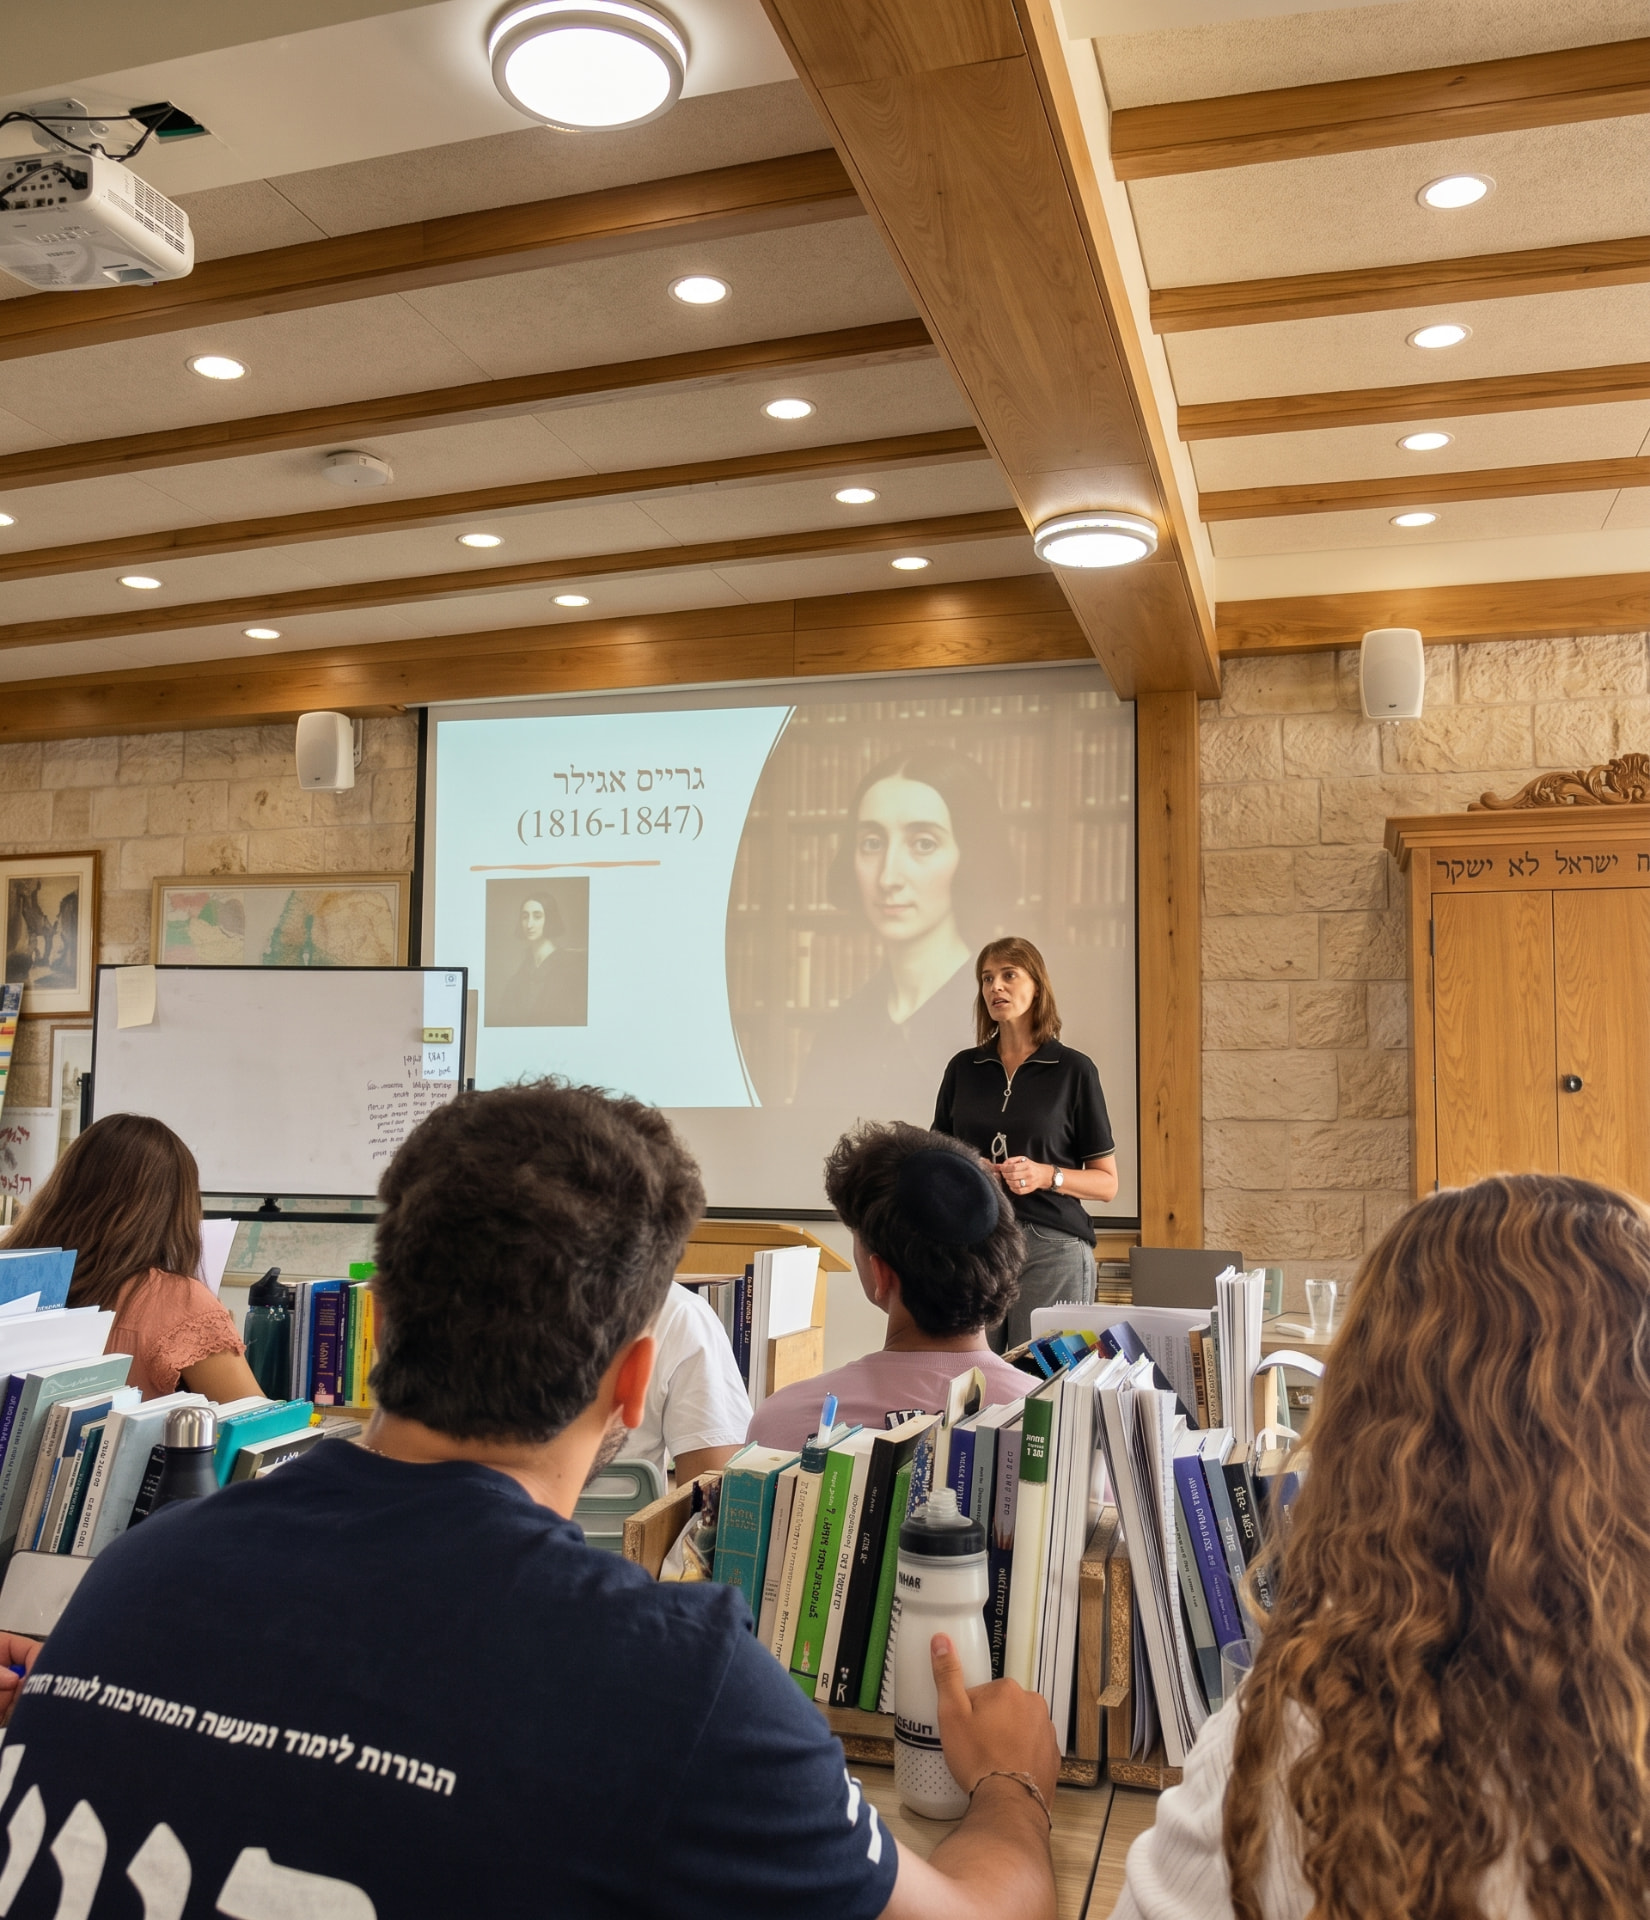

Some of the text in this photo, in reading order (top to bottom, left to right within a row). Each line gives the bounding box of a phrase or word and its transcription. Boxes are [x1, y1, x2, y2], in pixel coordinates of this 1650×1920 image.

[553, 764, 705, 795] גרייס אגילר
[517, 804, 704, 846] (1816-1847)
[1436, 858, 1494, 886] ישקר
[1508, 850, 1540, 878] לא
[1555, 849, 1619, 875] ישראל
[98, 1684, 197, 1729] המחויבות
[197, 1711, 279, 1749] ומעשה
[284, 1733, 355, 1764] לימוד
